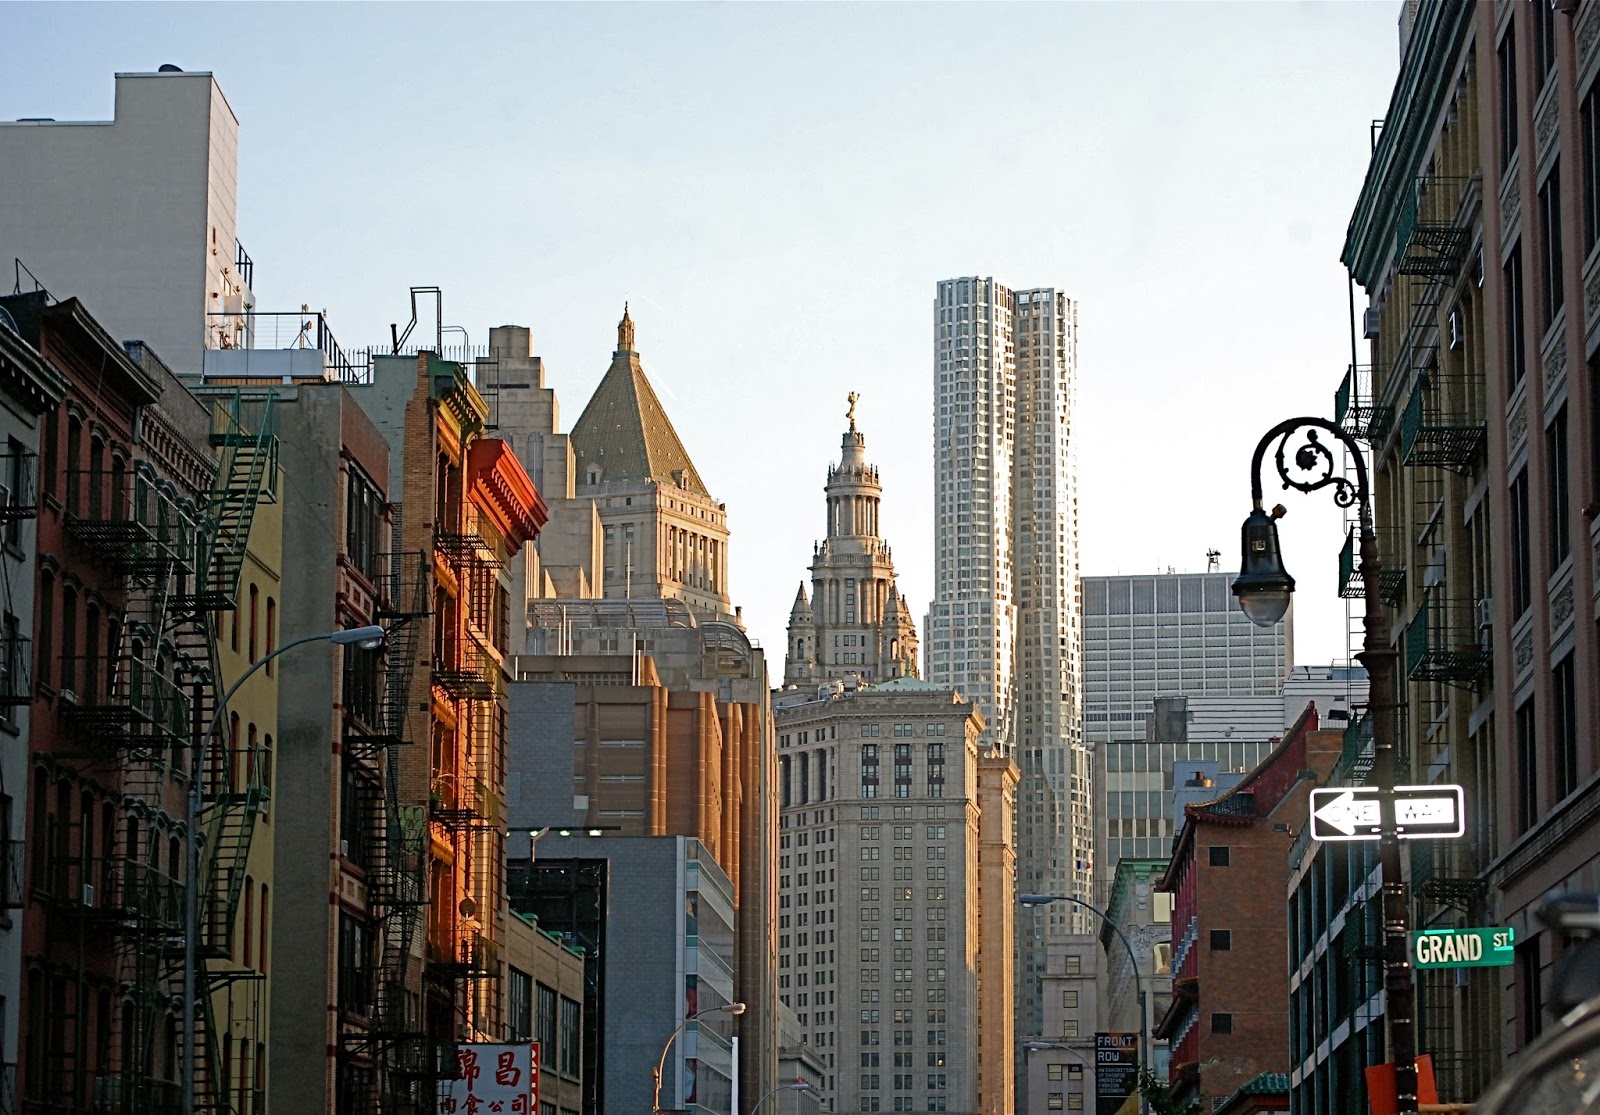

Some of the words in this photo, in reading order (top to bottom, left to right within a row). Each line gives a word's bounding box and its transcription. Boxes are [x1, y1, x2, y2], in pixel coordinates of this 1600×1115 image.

[1329, 805, 1375, 822] ONE
[1416, 934, 1482, 964] GRAND
[1493, 932, 1508, 947] ST
[1097, 1036, 1133, 1046] FRONT
[1097, 1051, 1120, 1062] ROW
